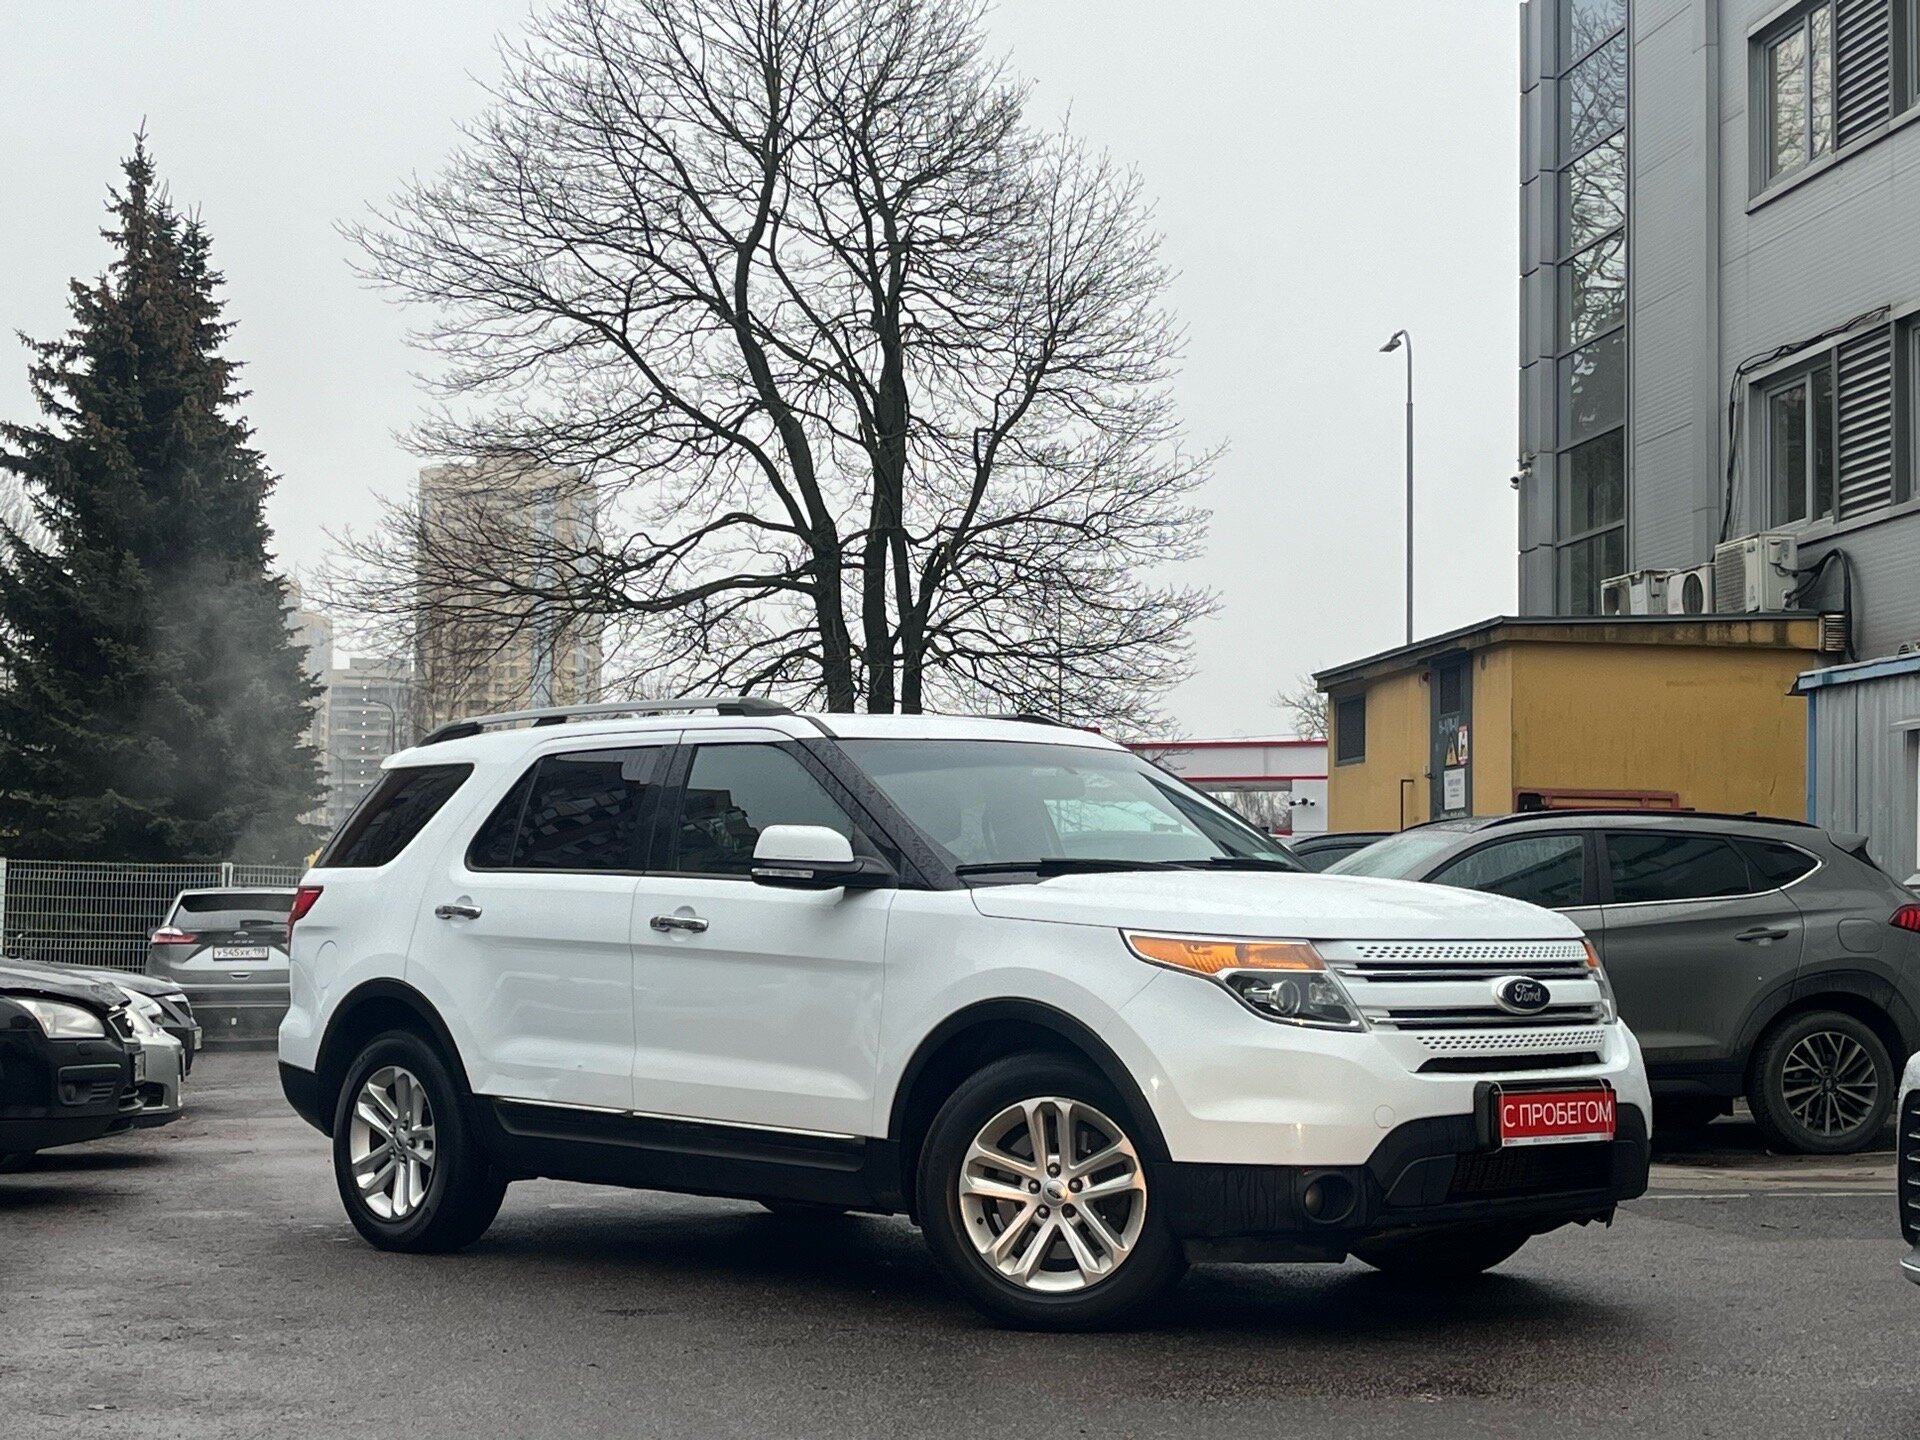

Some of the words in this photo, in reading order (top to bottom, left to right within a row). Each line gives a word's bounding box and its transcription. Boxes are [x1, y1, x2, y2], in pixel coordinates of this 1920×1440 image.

[1514, 983, 1542, 1003] Ford
[1503, 1104, 1516, 1128] С
[1519, 1101, 1613, 1127] ПРОБЕГОМ
